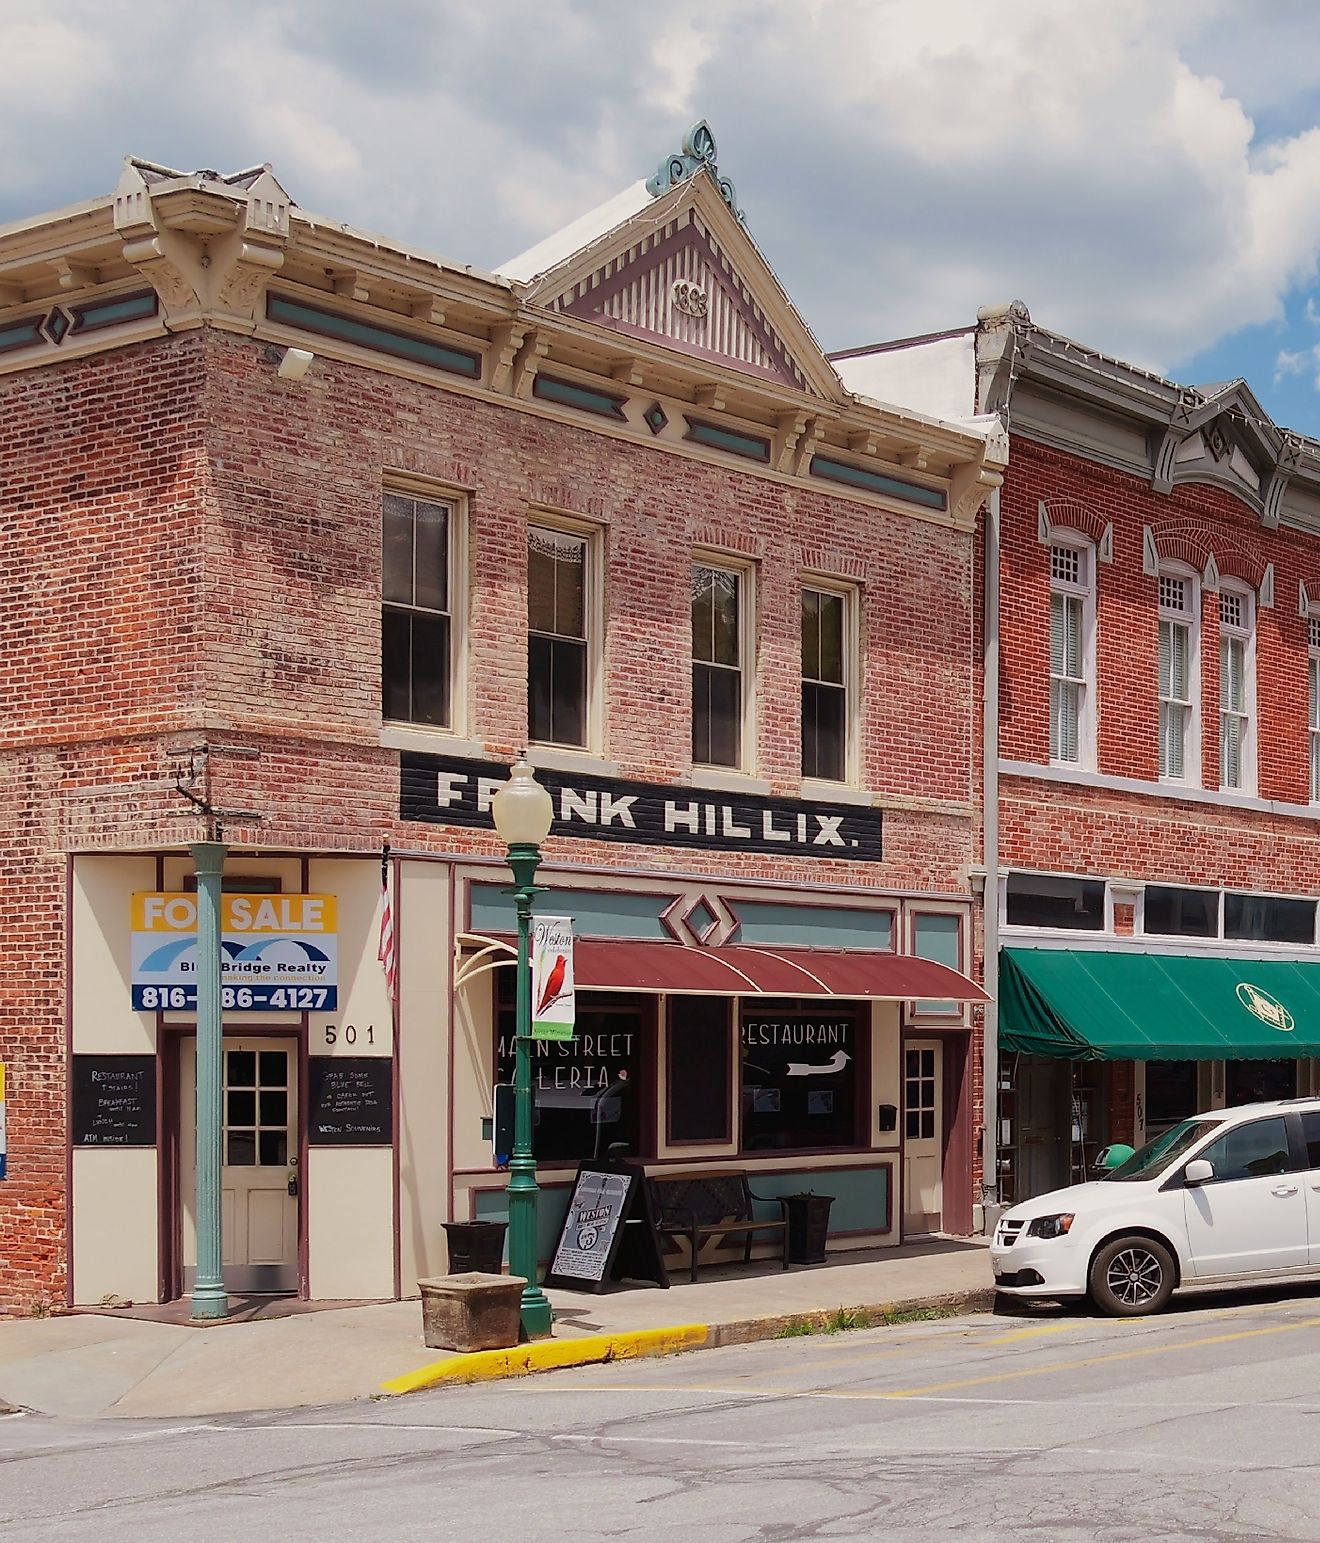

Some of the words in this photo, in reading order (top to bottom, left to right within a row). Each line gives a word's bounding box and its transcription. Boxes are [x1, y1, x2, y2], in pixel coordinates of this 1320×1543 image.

[144, 897, 198, 929] FO
[230, 899, 324, 930] SALE
[536, 921, 572, 946] Weston
[222, 962, 271, 974] Bridge
[277, 963, 327, 974] Realty
[142, 987, 328, 1008] 816-86-4127
[325, 1025, 374, 1044] 501
[558, 1034, 634, 1057] STREET
[92, 1070, 144, 1082] RESTAURANT
[84, 1133, 98, 1142] ATM
[580, 1205, 612, 1223] WESTON
